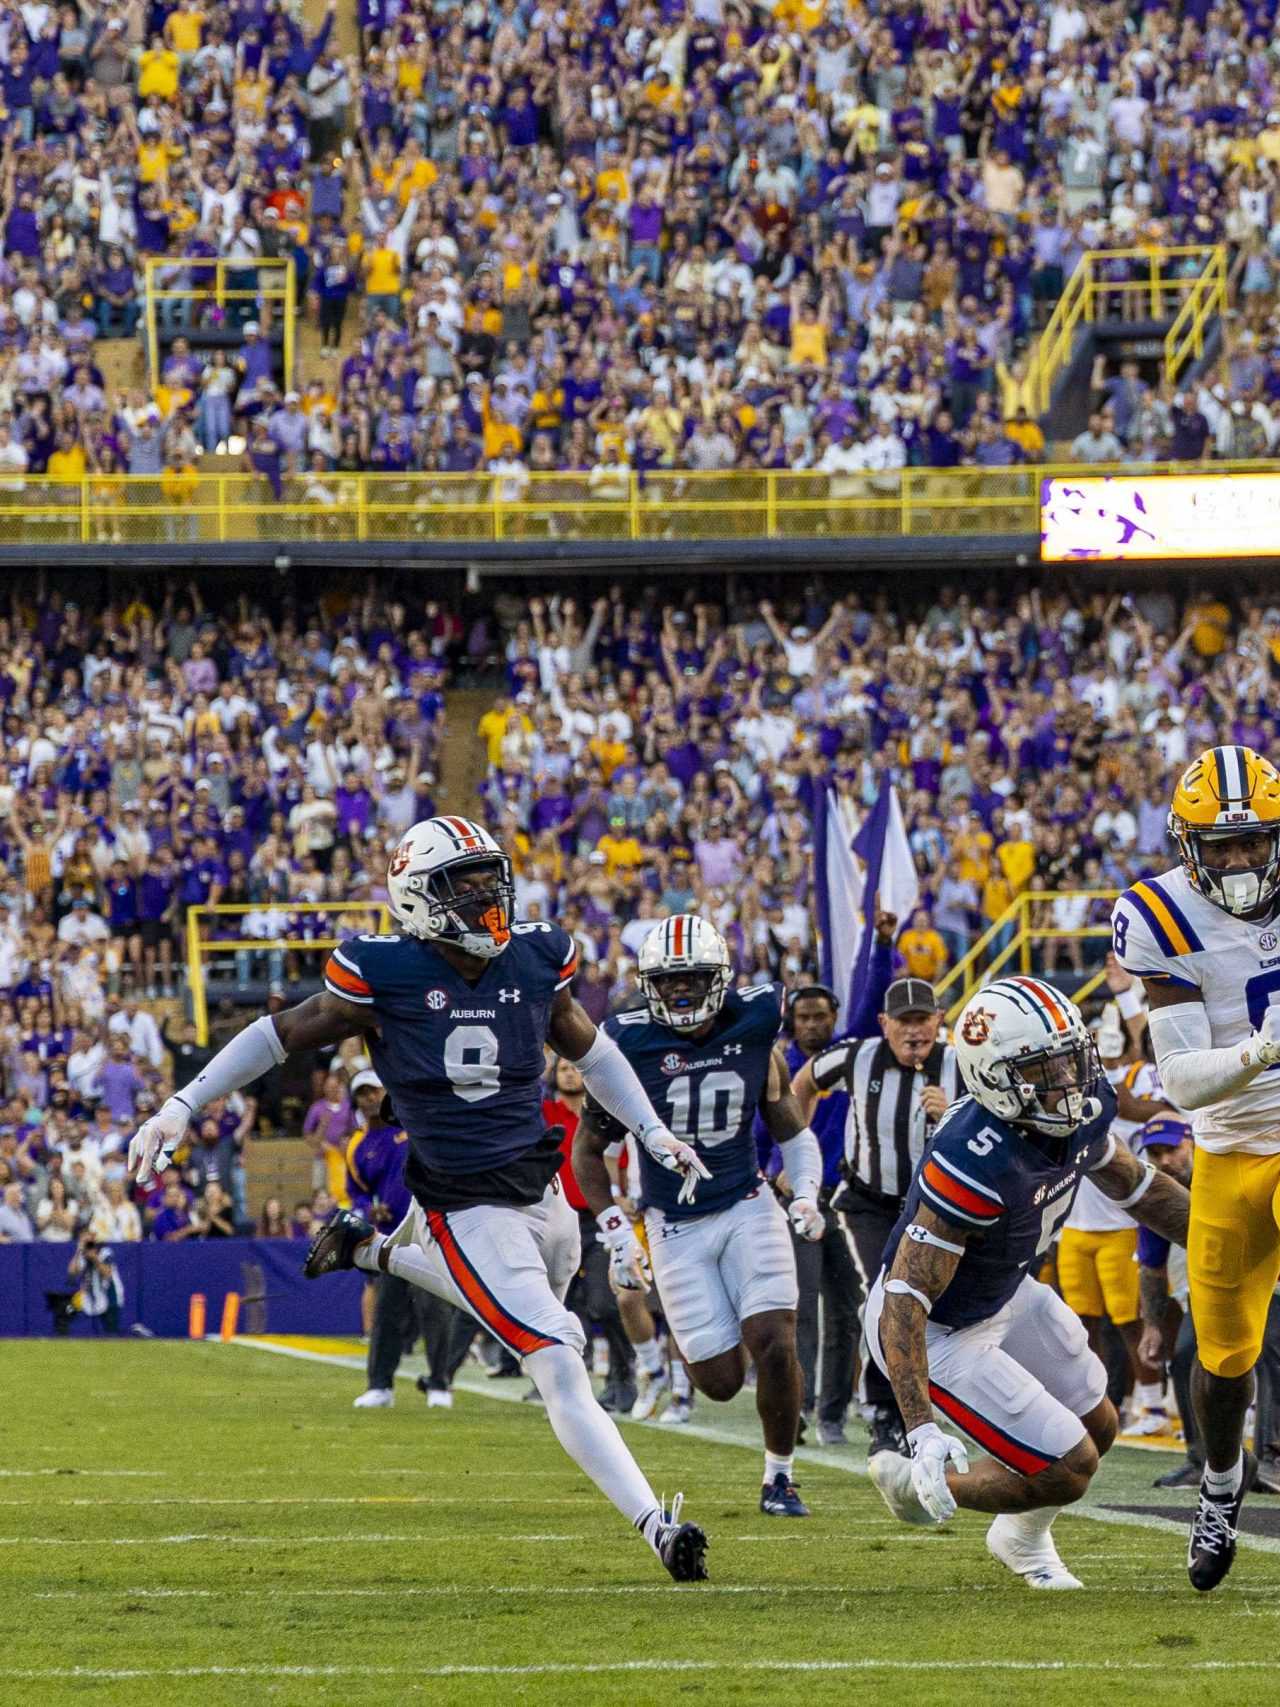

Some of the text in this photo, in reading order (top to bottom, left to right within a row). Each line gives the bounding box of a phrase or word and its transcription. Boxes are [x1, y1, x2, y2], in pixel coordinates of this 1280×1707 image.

[1225, 811, 1249, 823] LSU
[1113, 911, 1130, 958] 8
[1259, 932, 1278, 951] SEC
[426, 990, 447, 1010] SEC
[450, 1009, 496, 1019] AUBURN
[444, 1025, 501, 1103] 9
[684, 1057, 723, 1071] AUBURN
[870, 1080, 881, 1093] S
[666, 1071, 745, 1148] 10
[967, 1126, 1003, 1156] 5
